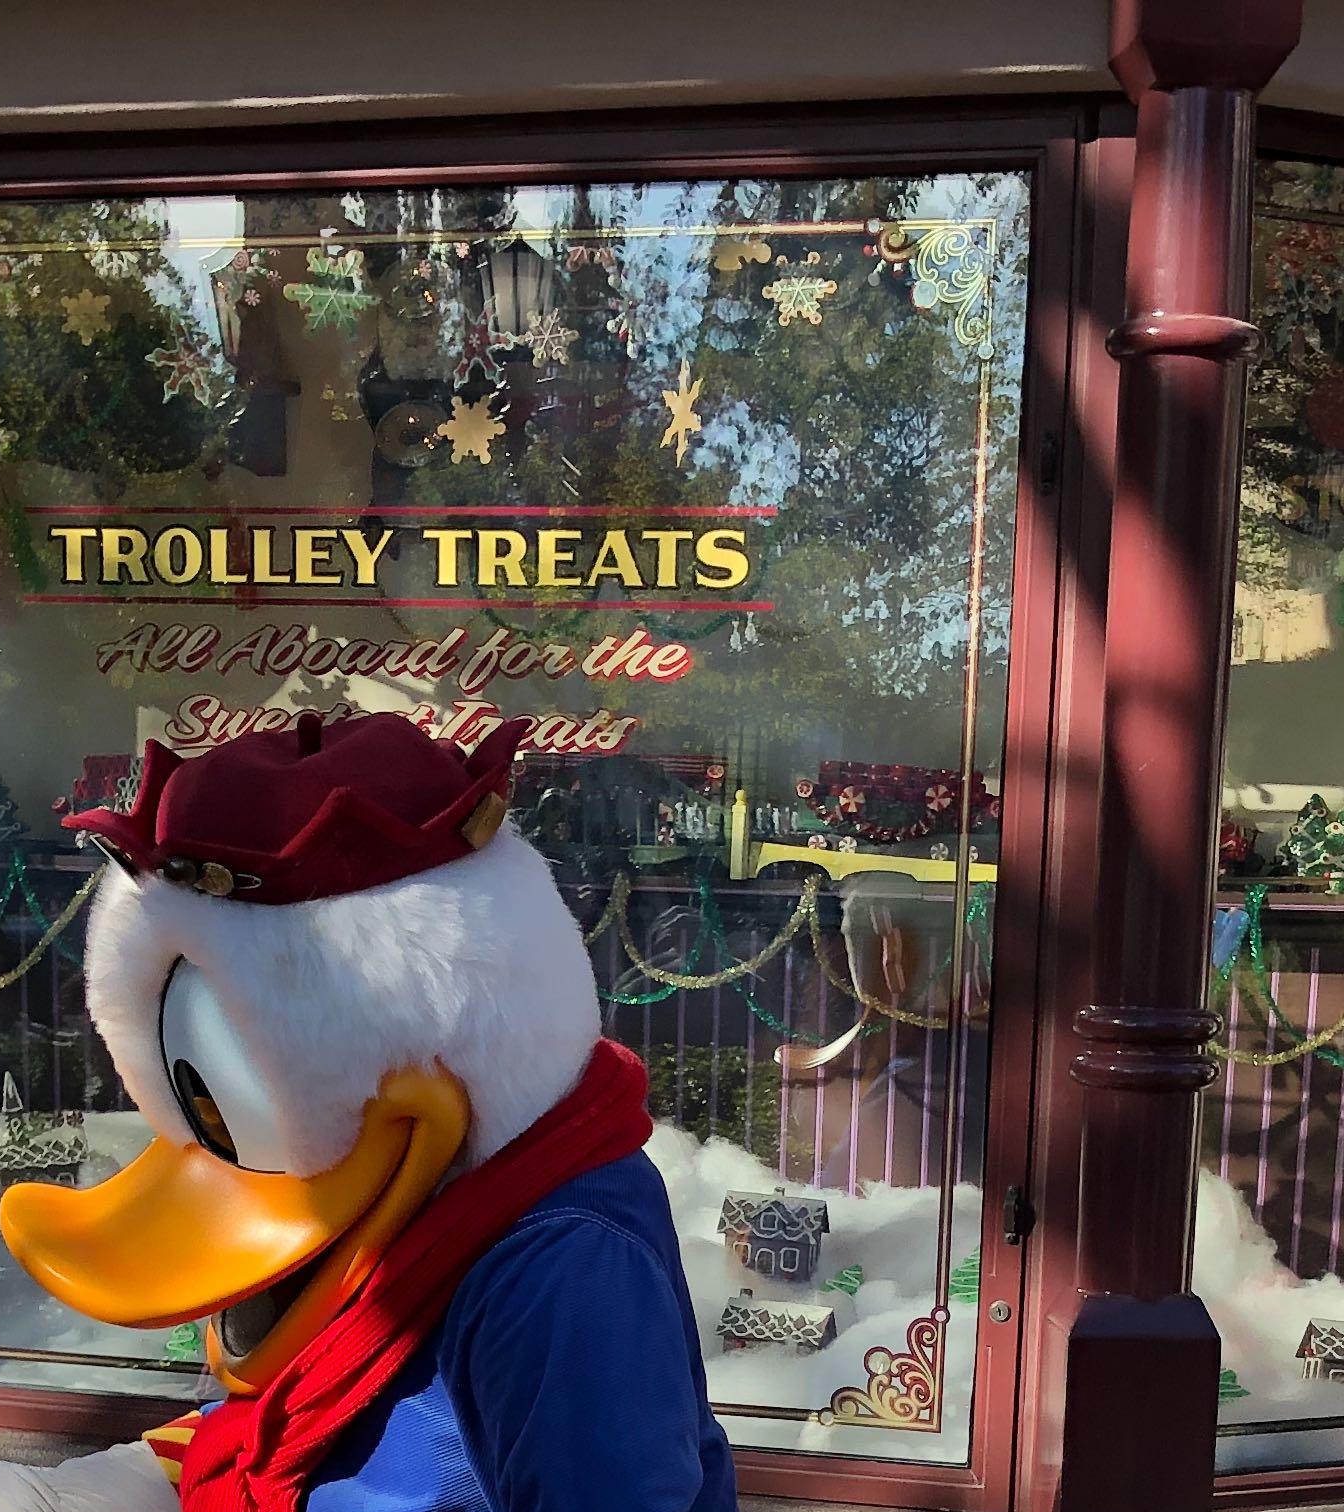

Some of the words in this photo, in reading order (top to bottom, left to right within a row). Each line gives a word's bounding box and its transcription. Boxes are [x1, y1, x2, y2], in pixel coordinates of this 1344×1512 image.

[48, 524, 394, 586] TROLLEY
[422, 526, 752, 589] TREATS
[96, 622, 222, 677] All
[216, 623, 464, 678] Aboard
[456, 627, 573, 695] for
[580, 628, 696, 682] the
